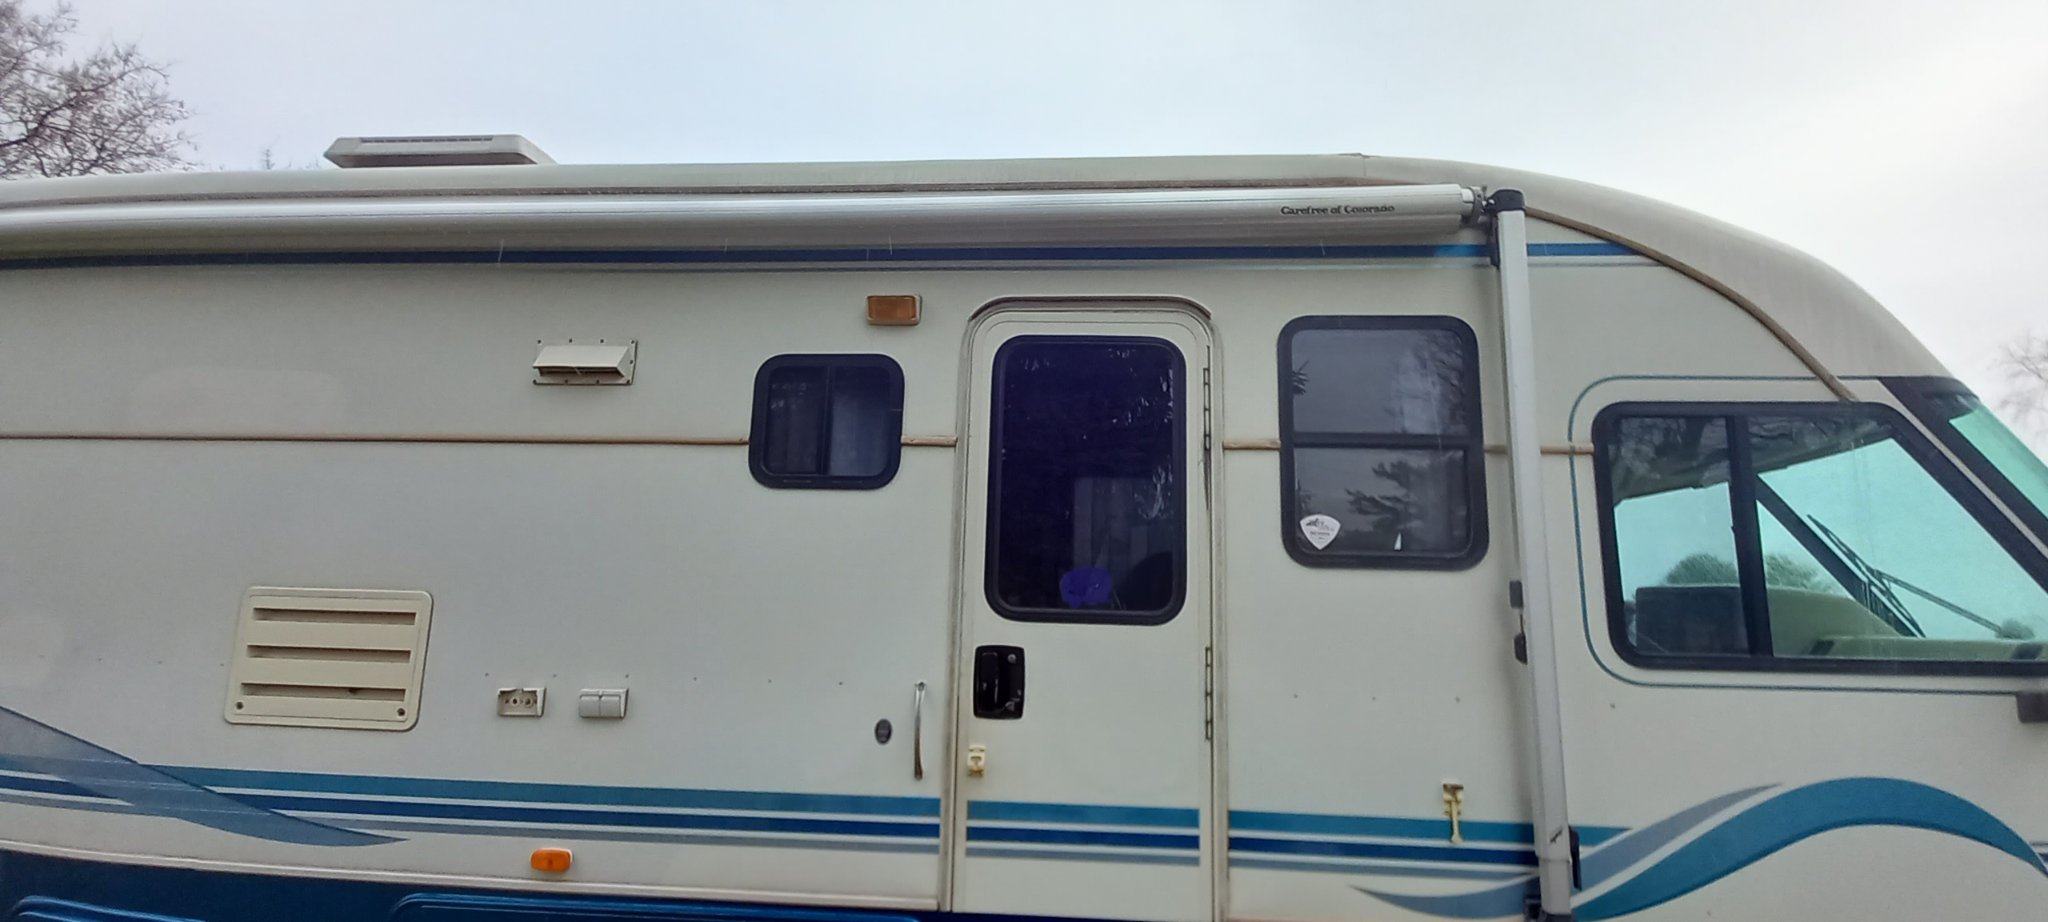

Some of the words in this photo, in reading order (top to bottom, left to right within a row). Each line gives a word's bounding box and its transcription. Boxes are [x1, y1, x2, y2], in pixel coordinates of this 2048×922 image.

[1280, 205, 1329, 215] Carefree
[1330, 205, 1341, 214] of
[1344, 204, 1396, 214] Colorado
